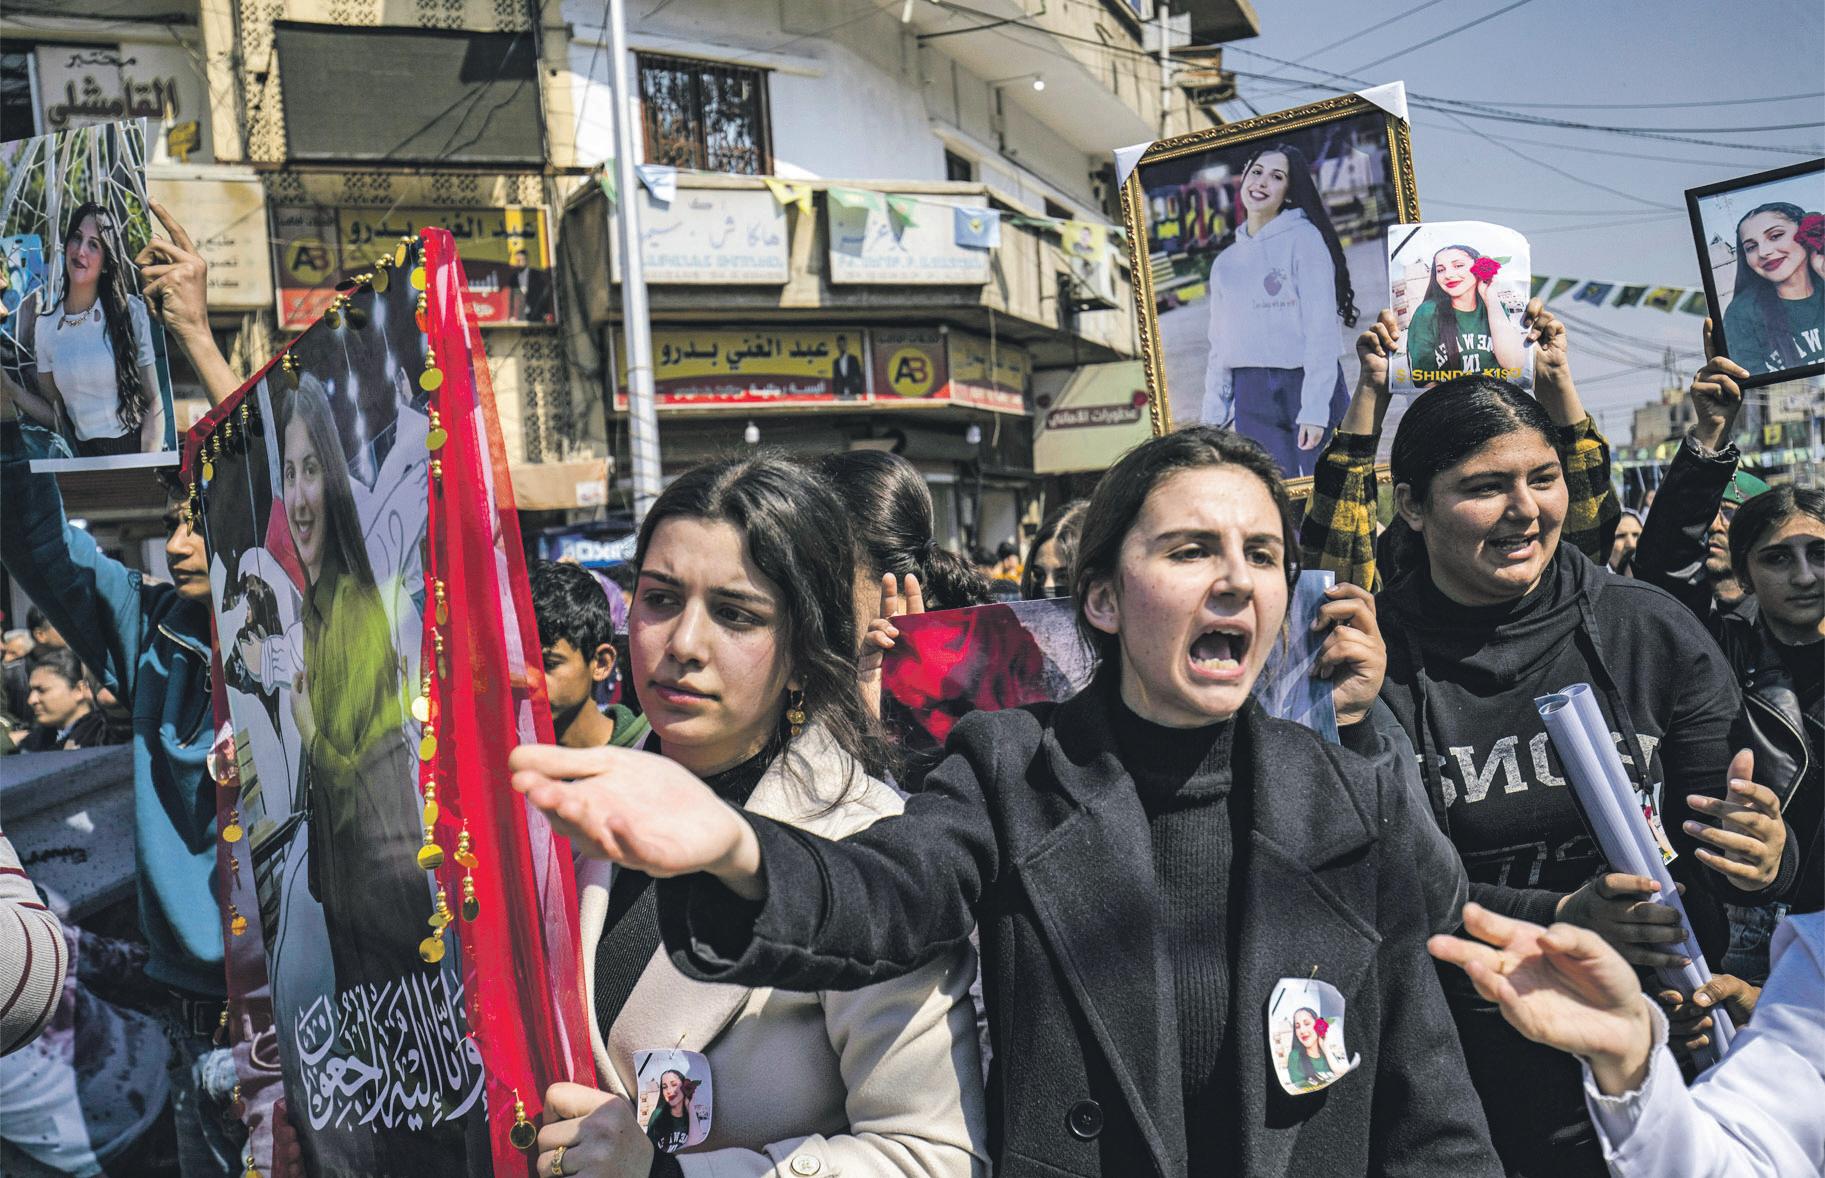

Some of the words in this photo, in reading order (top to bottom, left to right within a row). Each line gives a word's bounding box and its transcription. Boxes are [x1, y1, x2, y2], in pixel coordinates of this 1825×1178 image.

[48, 75, 179, 126] القامشلي
[660, 341, 718, 366] بدرو
[726, 334, 782, 369] الغني
[788, 336, 829, 365] عبد
[895, 356, 928, 385] AB
